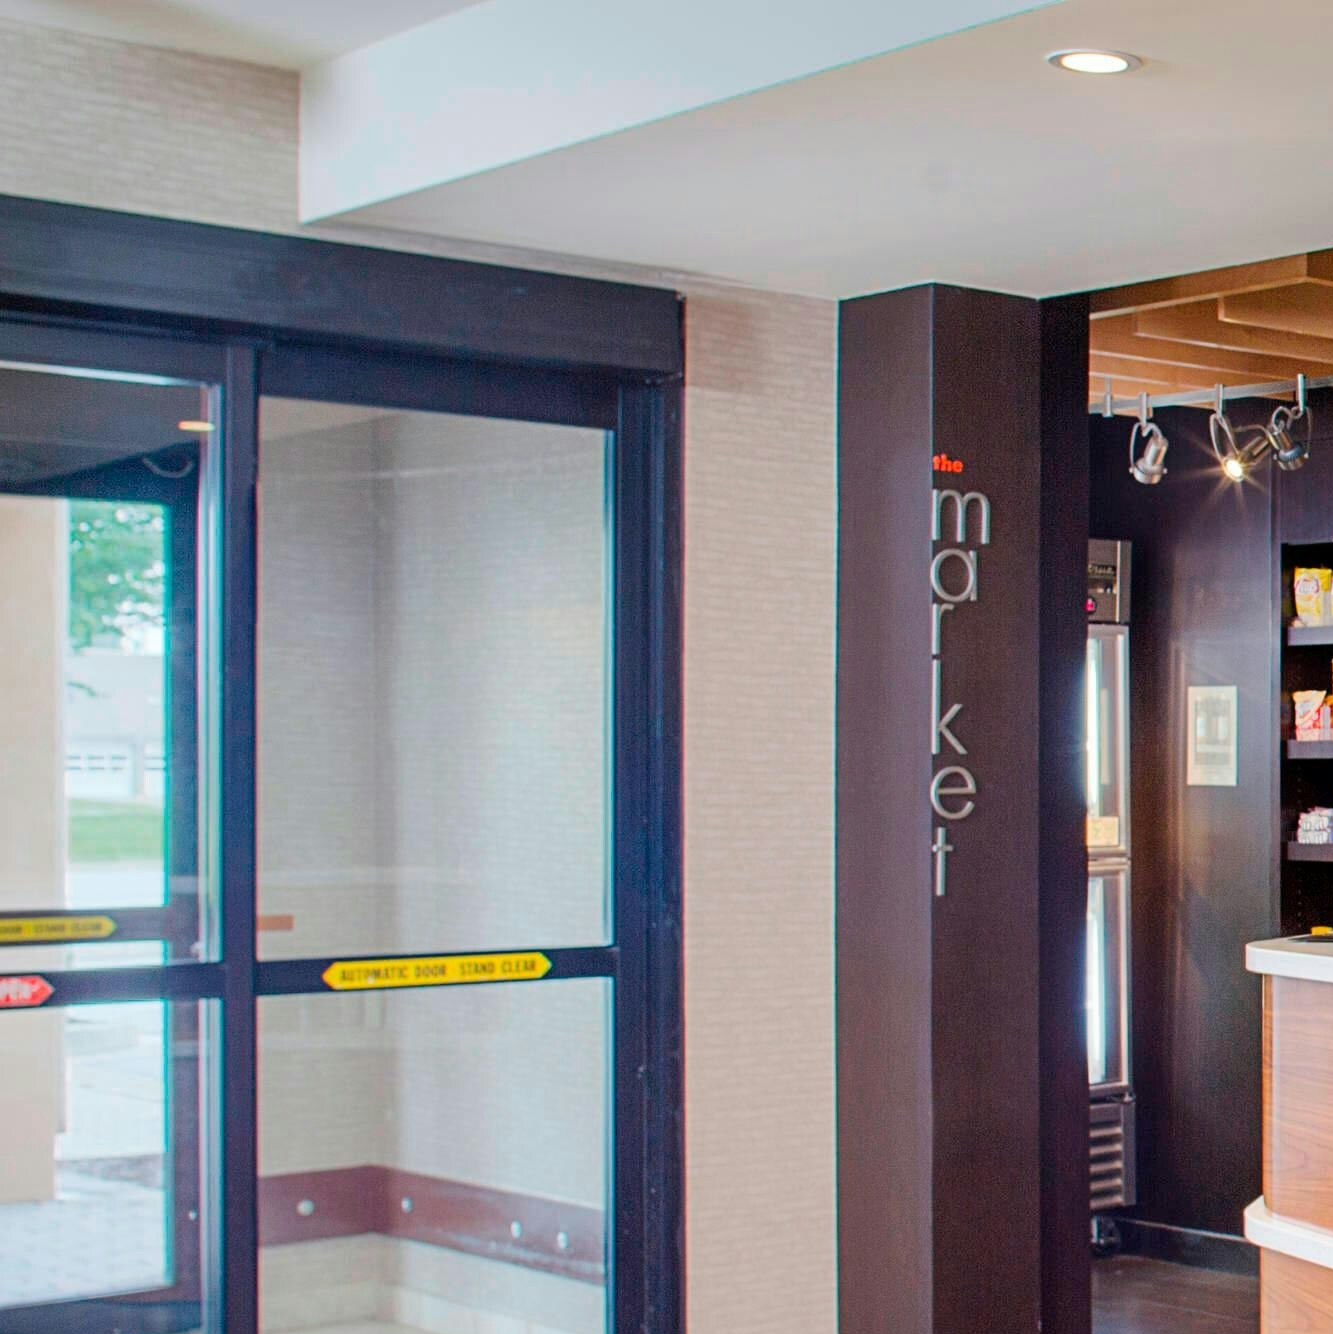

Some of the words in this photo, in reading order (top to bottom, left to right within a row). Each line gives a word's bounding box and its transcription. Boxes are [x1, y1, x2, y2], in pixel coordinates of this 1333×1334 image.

[932, 453, 964, 473] the
[930, 487, 991, 896] market
[340, 966, 409, 982] AUTOMATIC
[414, 963, 446, 979] DOOR
[459, 961, 495, 977] STAND
[501, 959, 537, 974] CLEAR
